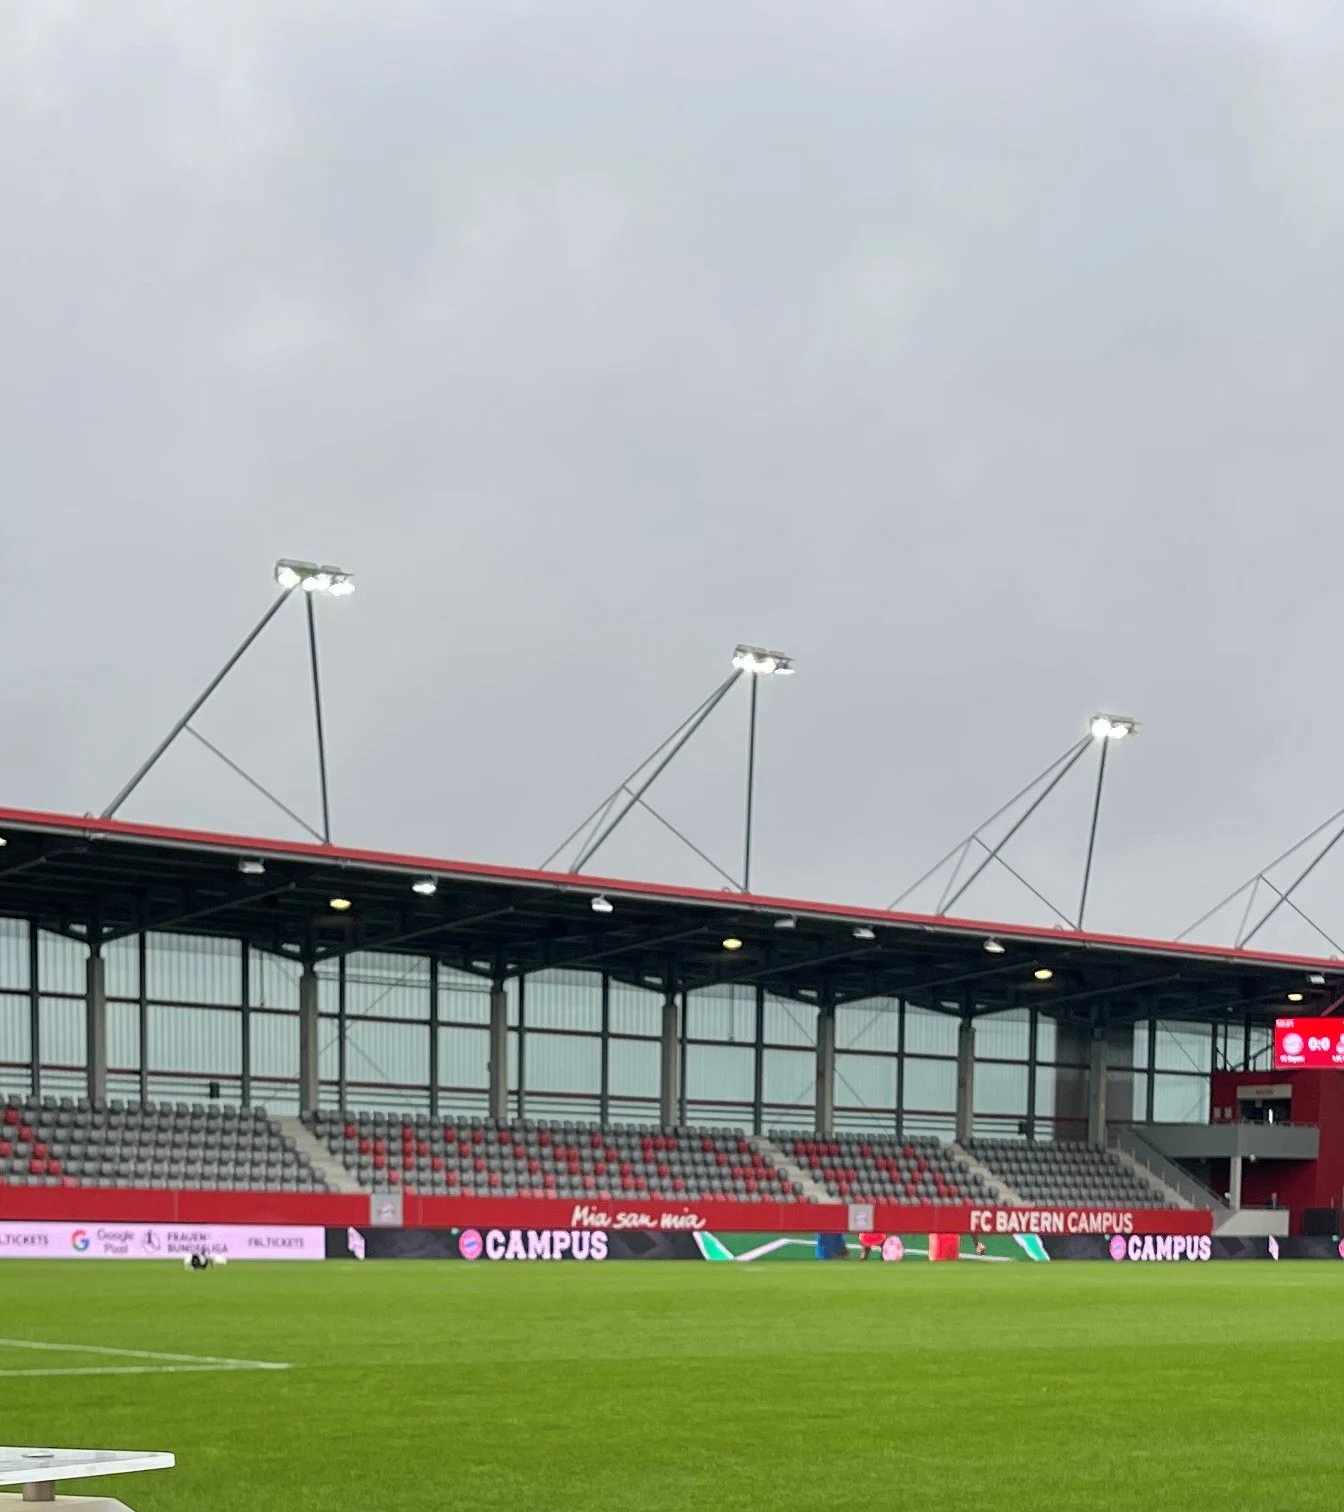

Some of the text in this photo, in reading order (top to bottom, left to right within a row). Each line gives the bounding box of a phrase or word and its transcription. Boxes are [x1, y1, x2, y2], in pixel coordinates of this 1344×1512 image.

[571, 1205, 706, 1231] Mia san mia
[970, 1210, 1134, 1234] FC BAYERN CAMPUS
[485, 1230, 608, 1260] CAMPUS
[1127, 1235, 1212, 1261] CAMPUS
